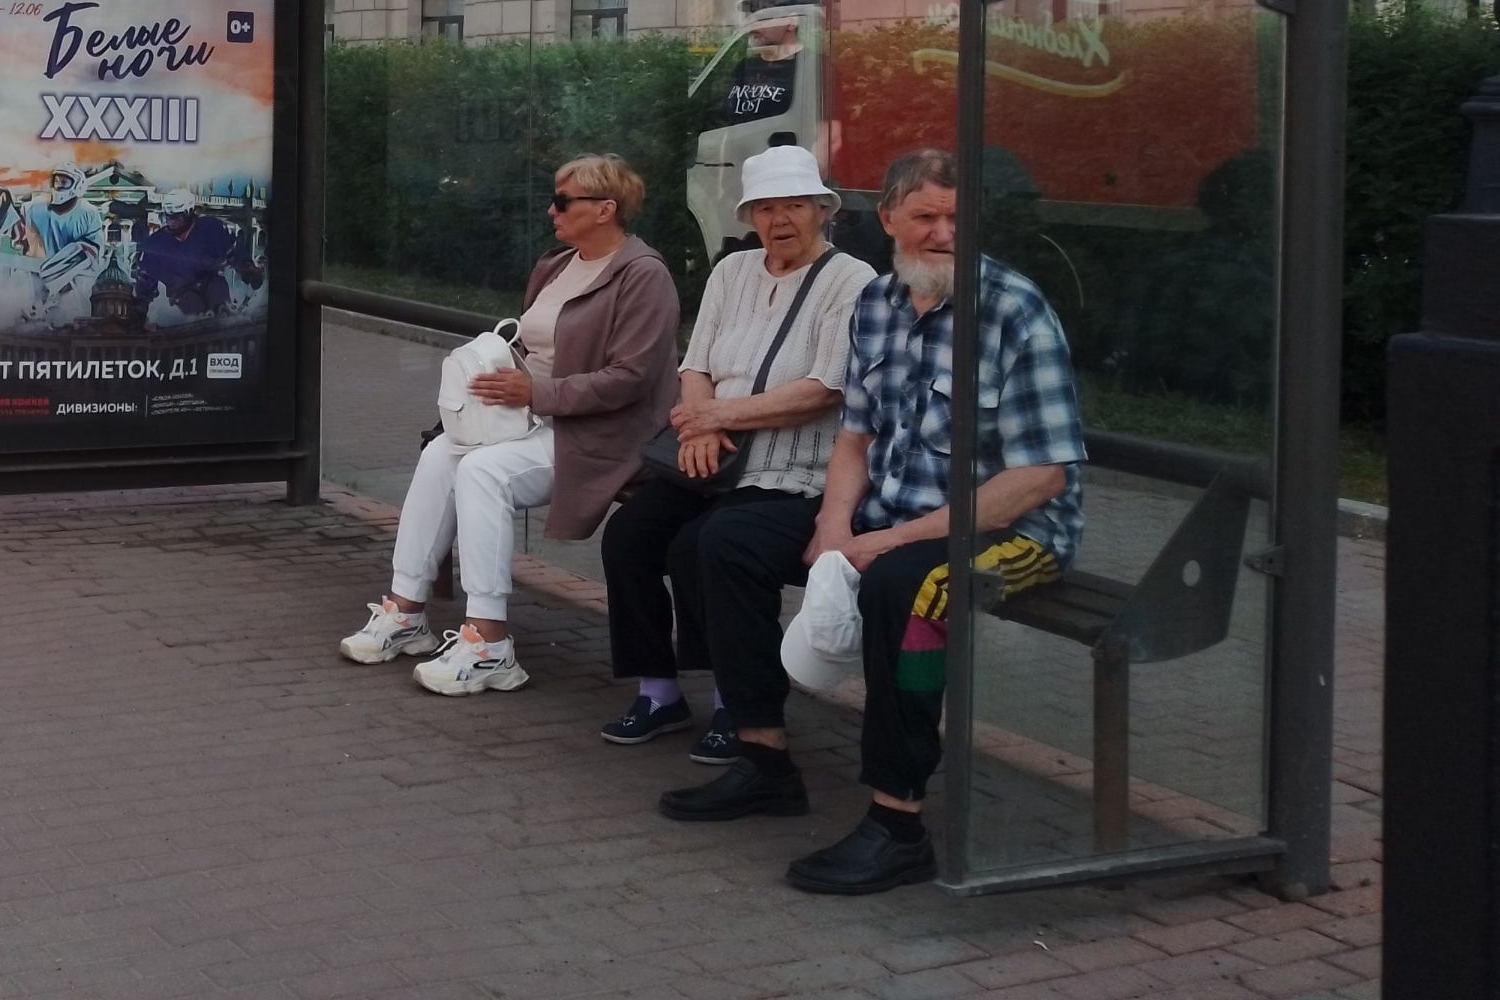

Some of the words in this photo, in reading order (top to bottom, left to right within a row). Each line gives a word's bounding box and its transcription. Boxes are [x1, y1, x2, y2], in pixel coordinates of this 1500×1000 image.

[9, 2, 44, 16] 12.06
[230, 19, 251, 34] 0+
[42, 2, 192, 79] Белые
[97, 41, 215, 81] ночи
[728, 84, 785, 102] PARADISE
[40, 95, 199, 142] XXXIII
[18, 360, 165, 381] ПЯТИЛЕТОК,
[168, 357, 198, 377] Д.1
[209, 357, 240, 368] ВХОД
